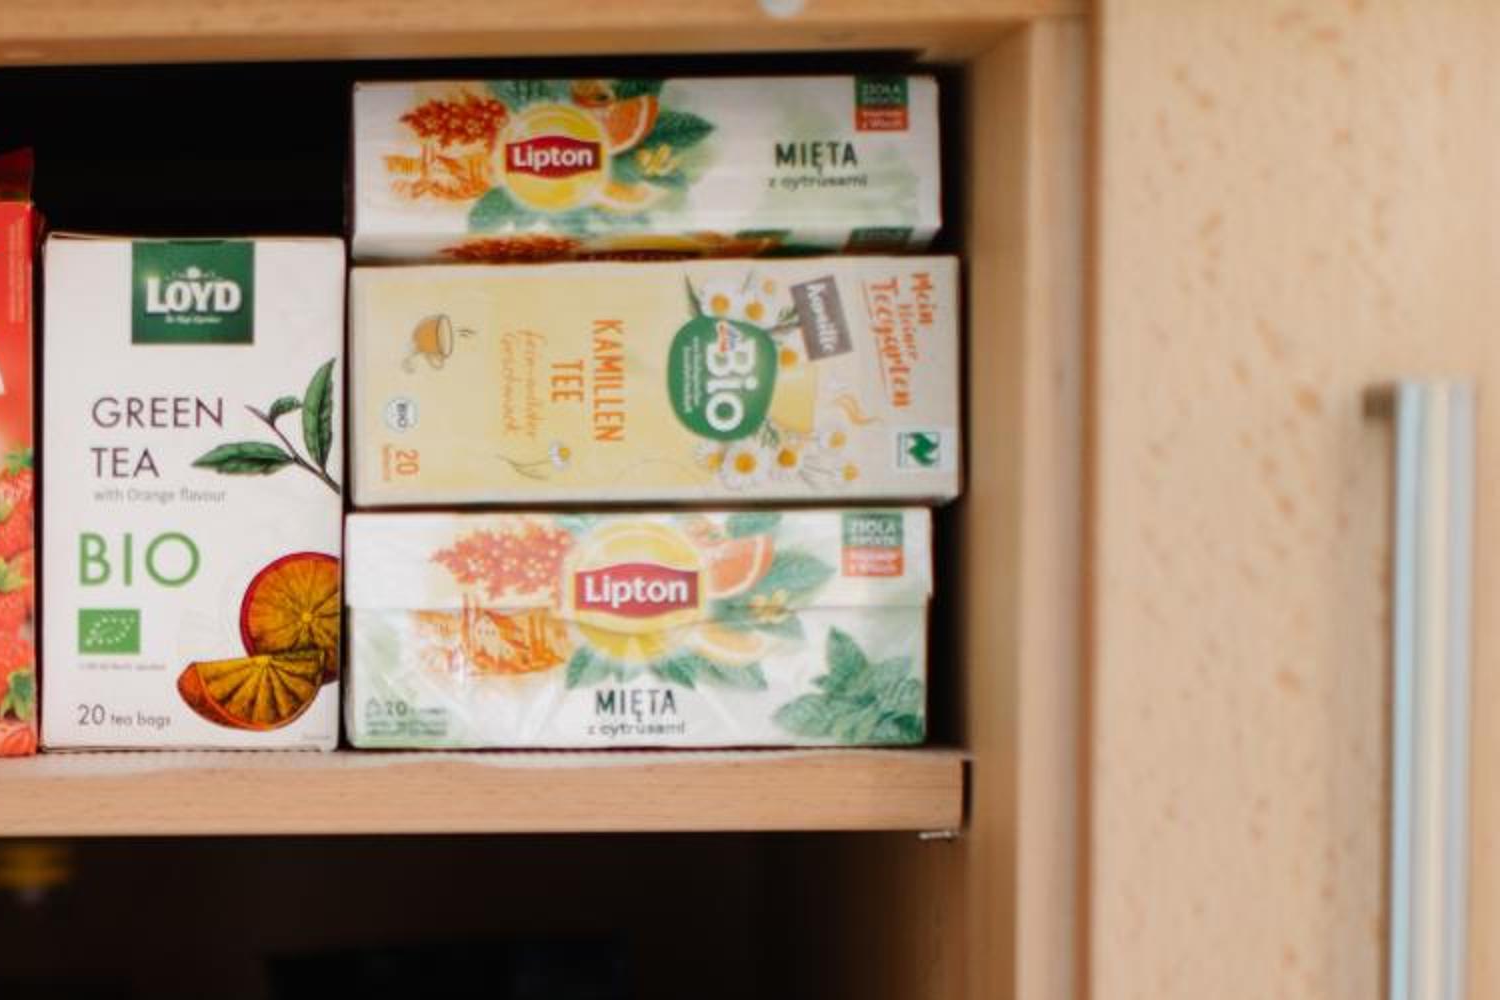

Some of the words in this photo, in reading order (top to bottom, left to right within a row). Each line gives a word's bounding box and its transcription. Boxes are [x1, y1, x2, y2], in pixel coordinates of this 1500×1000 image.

[513, 145, 593, 172] Lipton
[775, 142, 858, 175] MIĘTA
[146, 277, 242, 314] LOYD
[551, 359, 584, 403] TEE
[593, 319, 626, 442] KAMILLEN
[705, 340, 757, 432] Bio
[91, 396, 223, 429] GREEN
[91, 447, 161, 478] TEA
[396, 449, 419, 475] 20
[78, 531, 200, 588] BIO
[584, 575, 688, 609] Lipton
[77, 704, 105, 726] 20
[111, 712, 132, 726] tea
[136, 711, 171, 729] bags
[596, 689, 677, 723] MIĘTA
[600, 720, 686, 738] cytrusami
